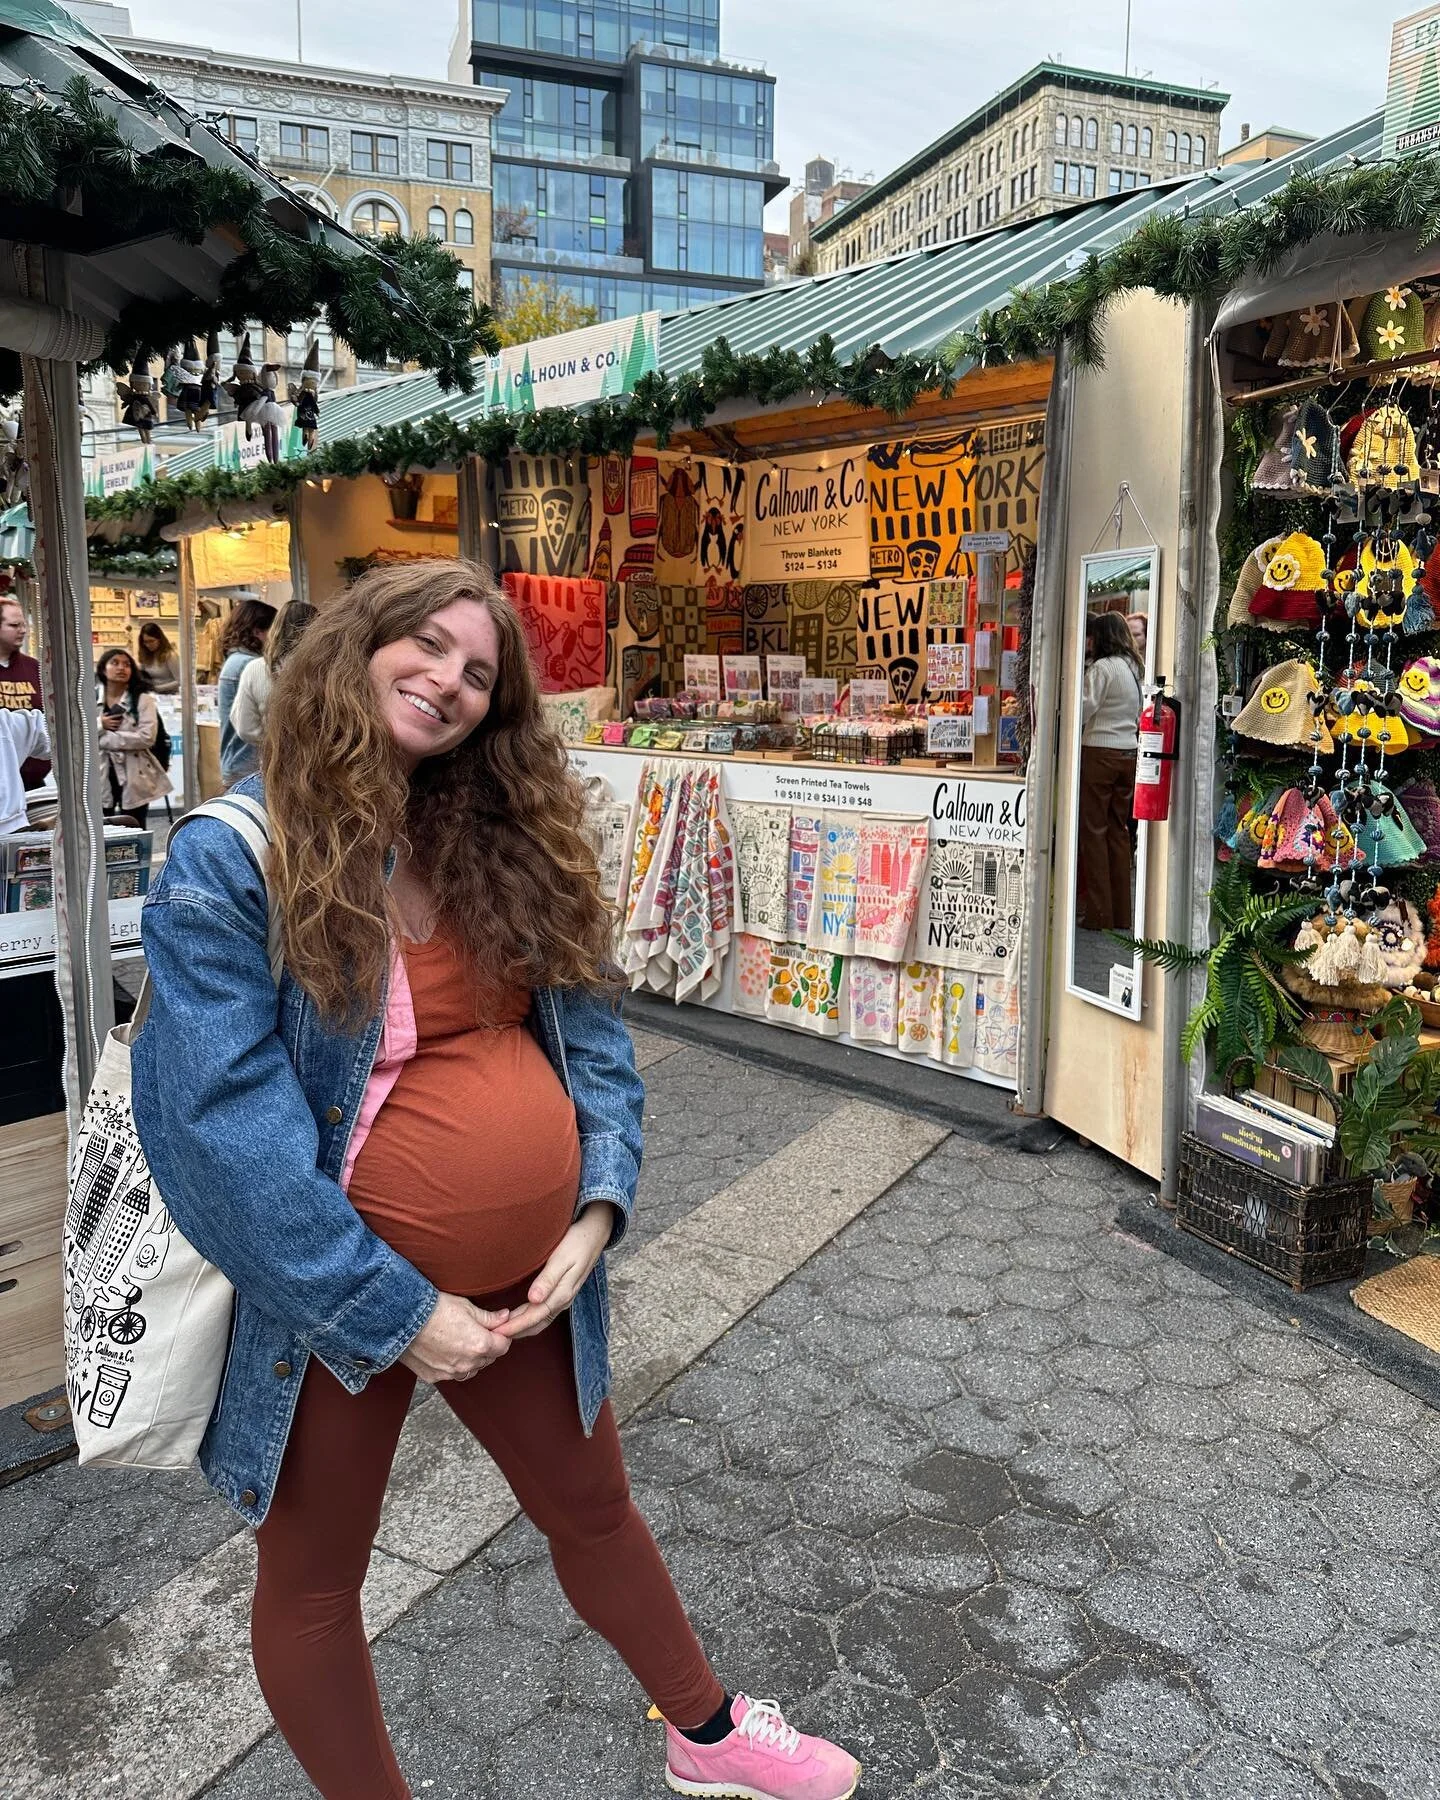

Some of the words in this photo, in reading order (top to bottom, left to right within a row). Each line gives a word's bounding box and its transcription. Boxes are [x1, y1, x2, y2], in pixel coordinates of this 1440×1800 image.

[514, 360, 577, 388] CALHOUN
[581, 357, 591, 373] &
[595, 351, 620, 369] CO.
[756, 467, 818, 521] Calhoun
[825, 478, 838, 511] &
[839, 459, 868, 507] Co.
[870, 470, 946, 518] NEW
[501, 498, 535, 516] METRO
[774, 522, 805, 537] NEW
[811, 513, 849, 532] YORK
[781, 551, 804, 560] Throw
[807, 547, 842, 559] Blankets
[784, 562, 804, 572] $124
[817, 559, 838, 571] $134
[776, 775, 799, 785] Screen
[801, 778, 827, 787] Printed
[830, 780, 842, 788] Tea
[844, 781, 870, 791] Towels
[788, 791, 801, 800] $18
[807, 793, 812, 801] 2
[822, 794, 836, 803] $34
[842, 796, 847, 804] 3
[857, 797, 872, 806] $48
[933, 782, 994, 824] Calhoun
[1000, 801, 1012, 826] &
[950, 825, 980, 838] NEW
[986, 827, 1022, 842] YORK
[931, 892, 958, 903] NEW
[961, 894, 991, 907] YORK
[0, 936, 42, 952] erry
[110, 921, 139, 937] igh
[823, 912, 842, 937] NY
[928, 922, 956, 948] NY
